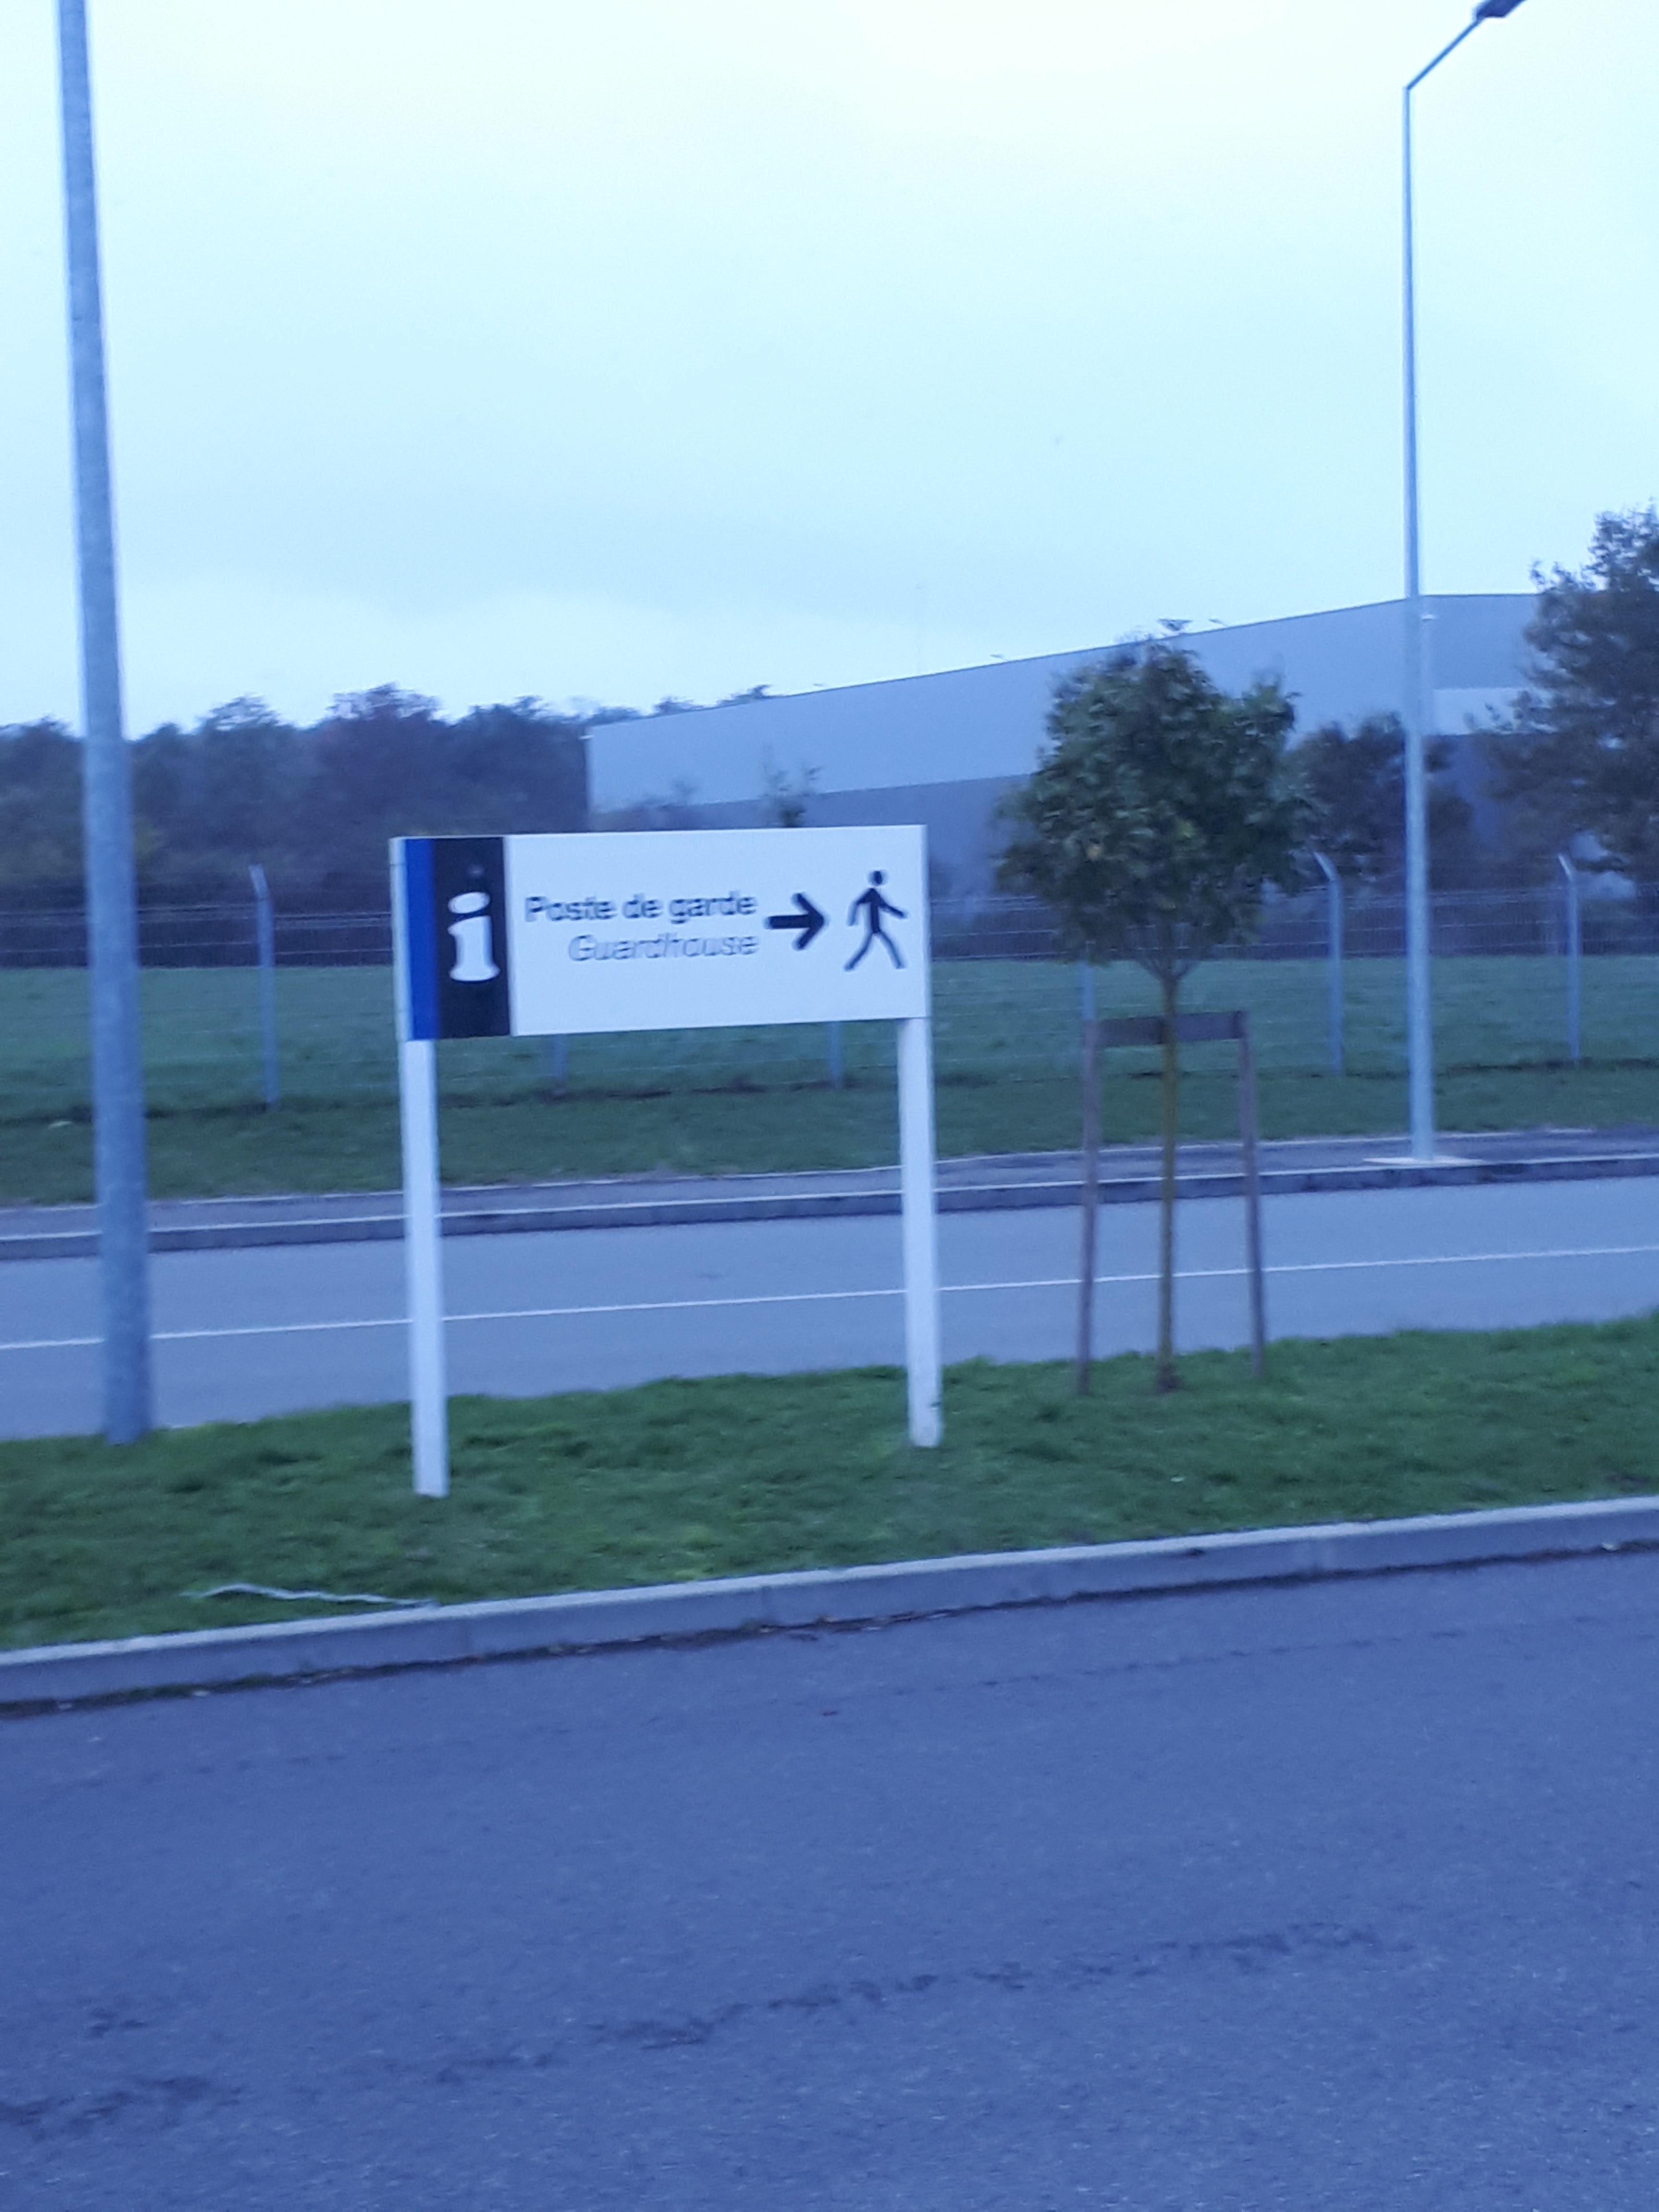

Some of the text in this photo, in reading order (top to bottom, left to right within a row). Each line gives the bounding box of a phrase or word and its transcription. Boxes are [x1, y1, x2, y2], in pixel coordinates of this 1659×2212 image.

[525, 890, 757, 925] Poste de garde
[568, 932, 759, 962] Guardhouse
